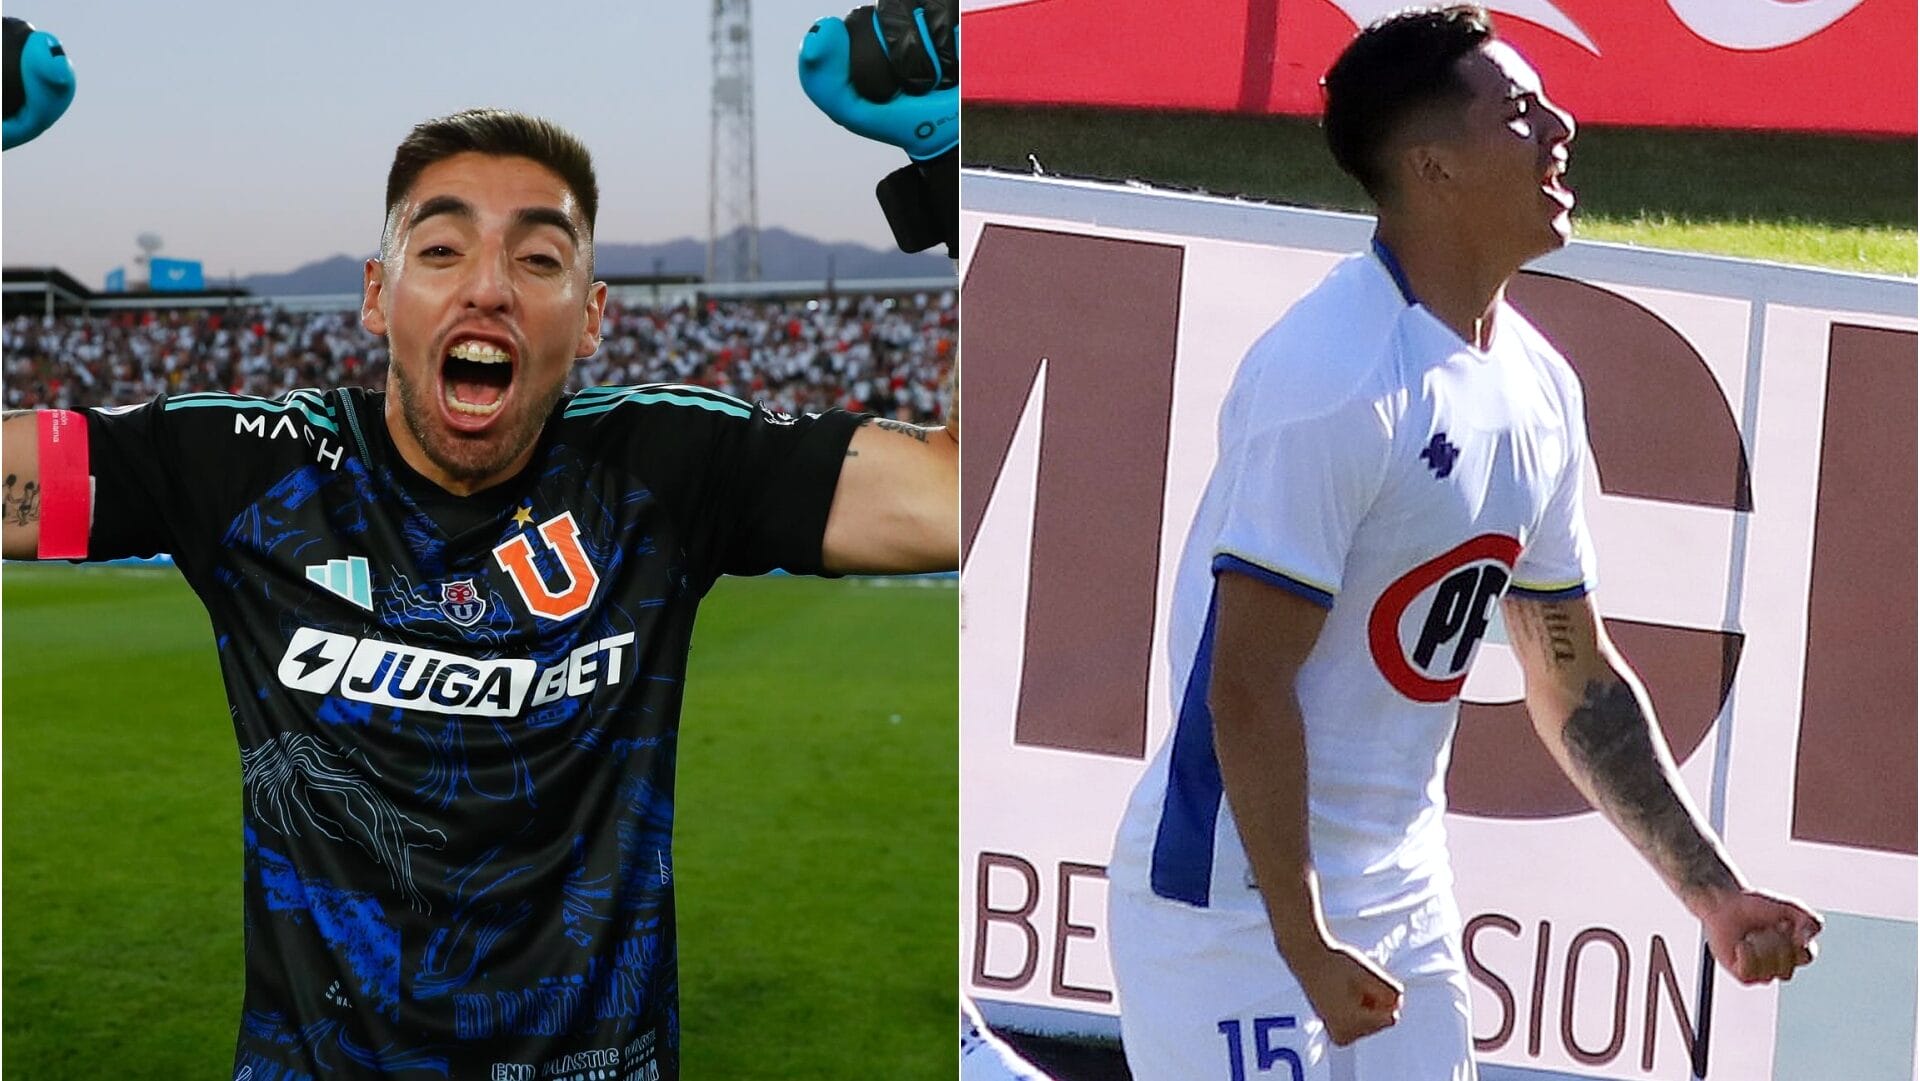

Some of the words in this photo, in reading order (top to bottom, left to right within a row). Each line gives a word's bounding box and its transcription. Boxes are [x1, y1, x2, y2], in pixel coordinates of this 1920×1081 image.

[491, 510, 600, 621] U
[452, 603, 473, 620] U
[972, 851, 1114, 1004] BE
[1461, 912, 1716, 1080] SION
[1217, 1016, 1305, 1081] 15
